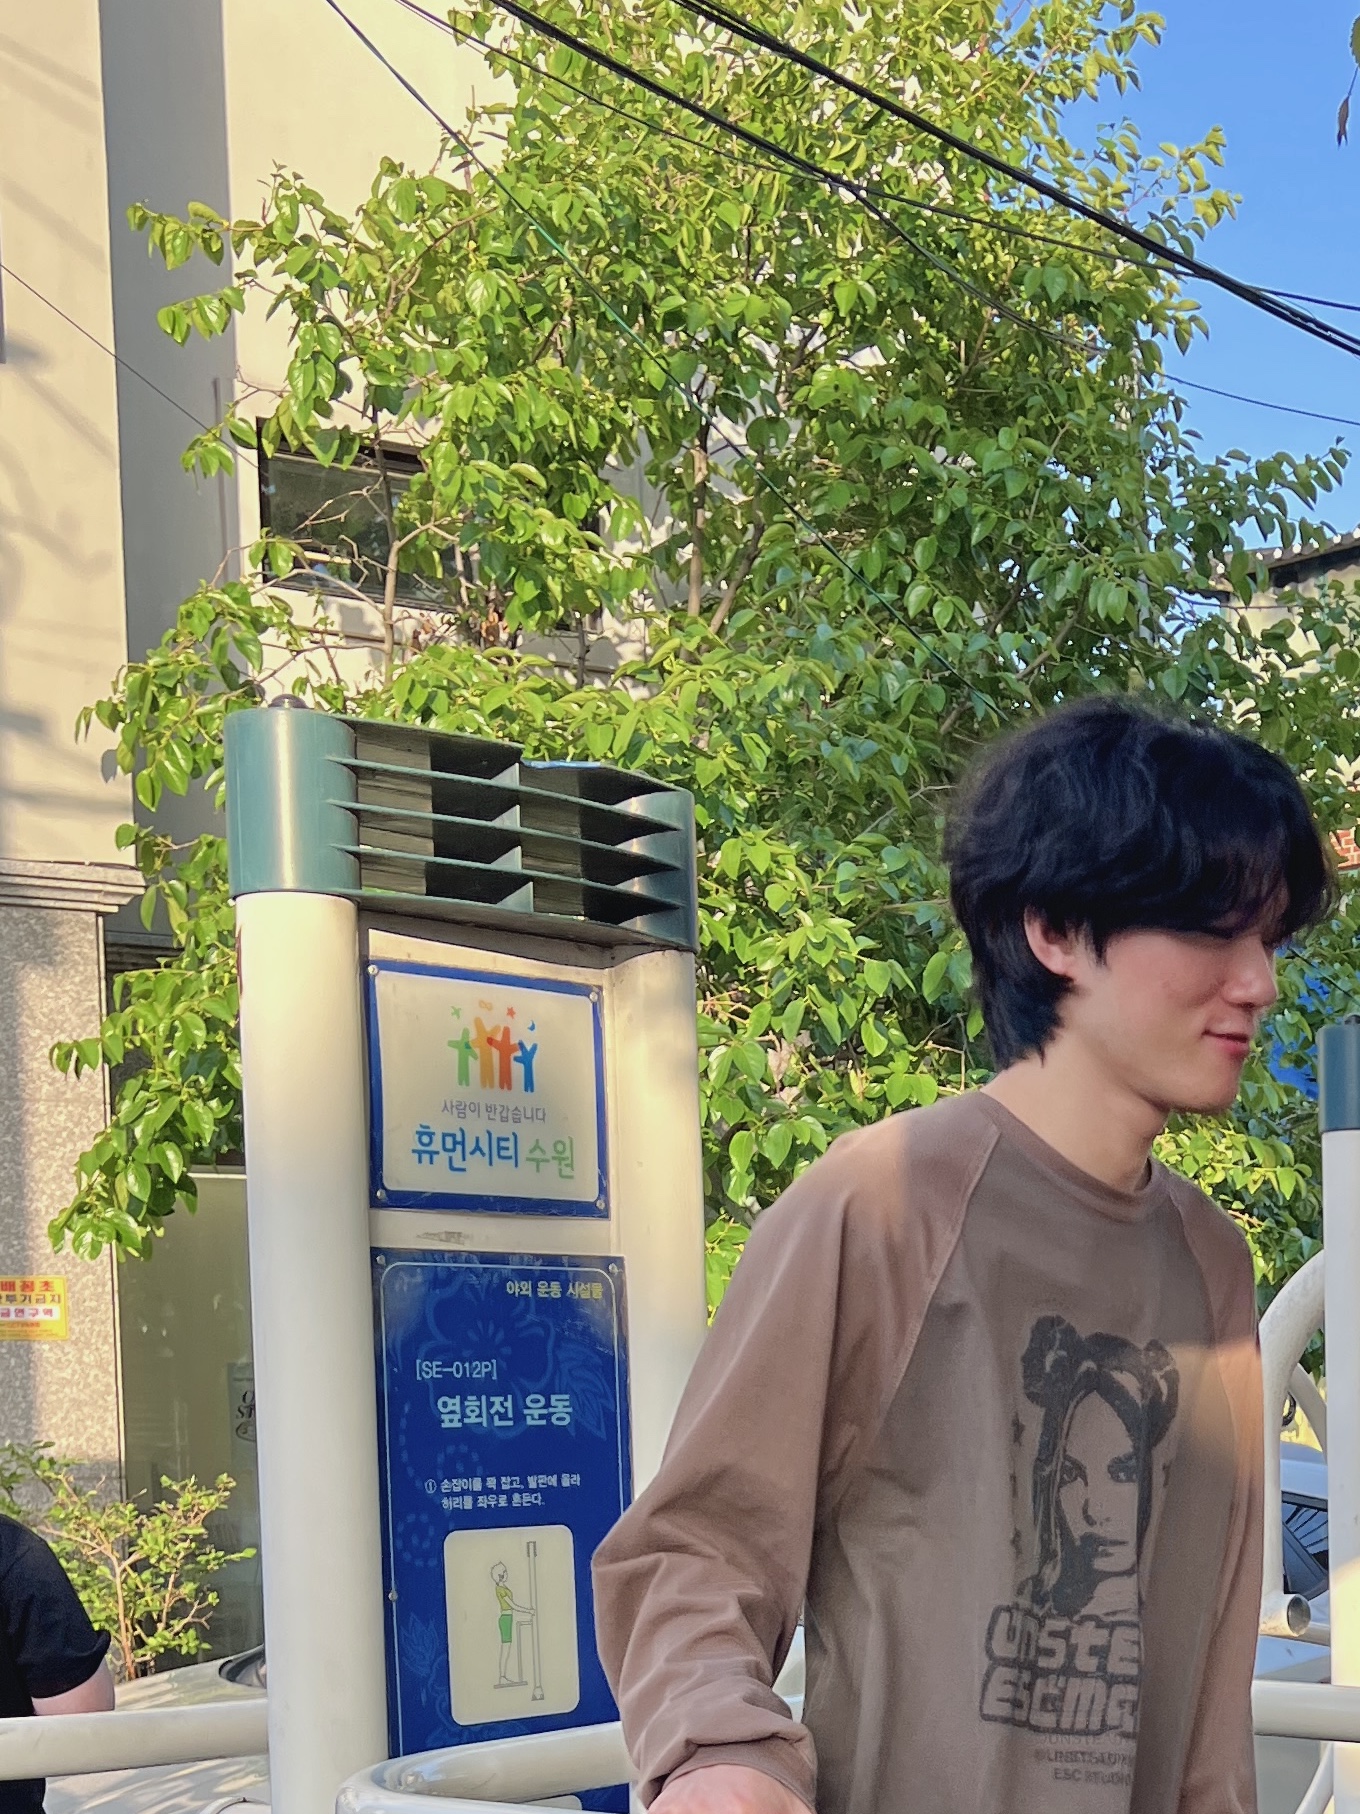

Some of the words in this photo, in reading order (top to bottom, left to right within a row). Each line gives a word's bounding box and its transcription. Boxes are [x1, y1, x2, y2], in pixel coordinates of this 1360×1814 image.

[442, 1100, 481, 1118] 사람이
[485, 1102, 546, 1123] 반갑습니다
[412, 1124, 519, 1172] 휴먼시티
[526, 1137, 575, 1179] 수원
[506, 1281, 532, 1297] 야외
[537, 1282, 562, 1298] 운동
[416, 1359, 497, 1380] [SE-012P]
[437, 1394, 514, 1428] 옆회전
[523, 1393, 573, 1425] 운동
[440, 1476, 482, 1493] 손잡이를
